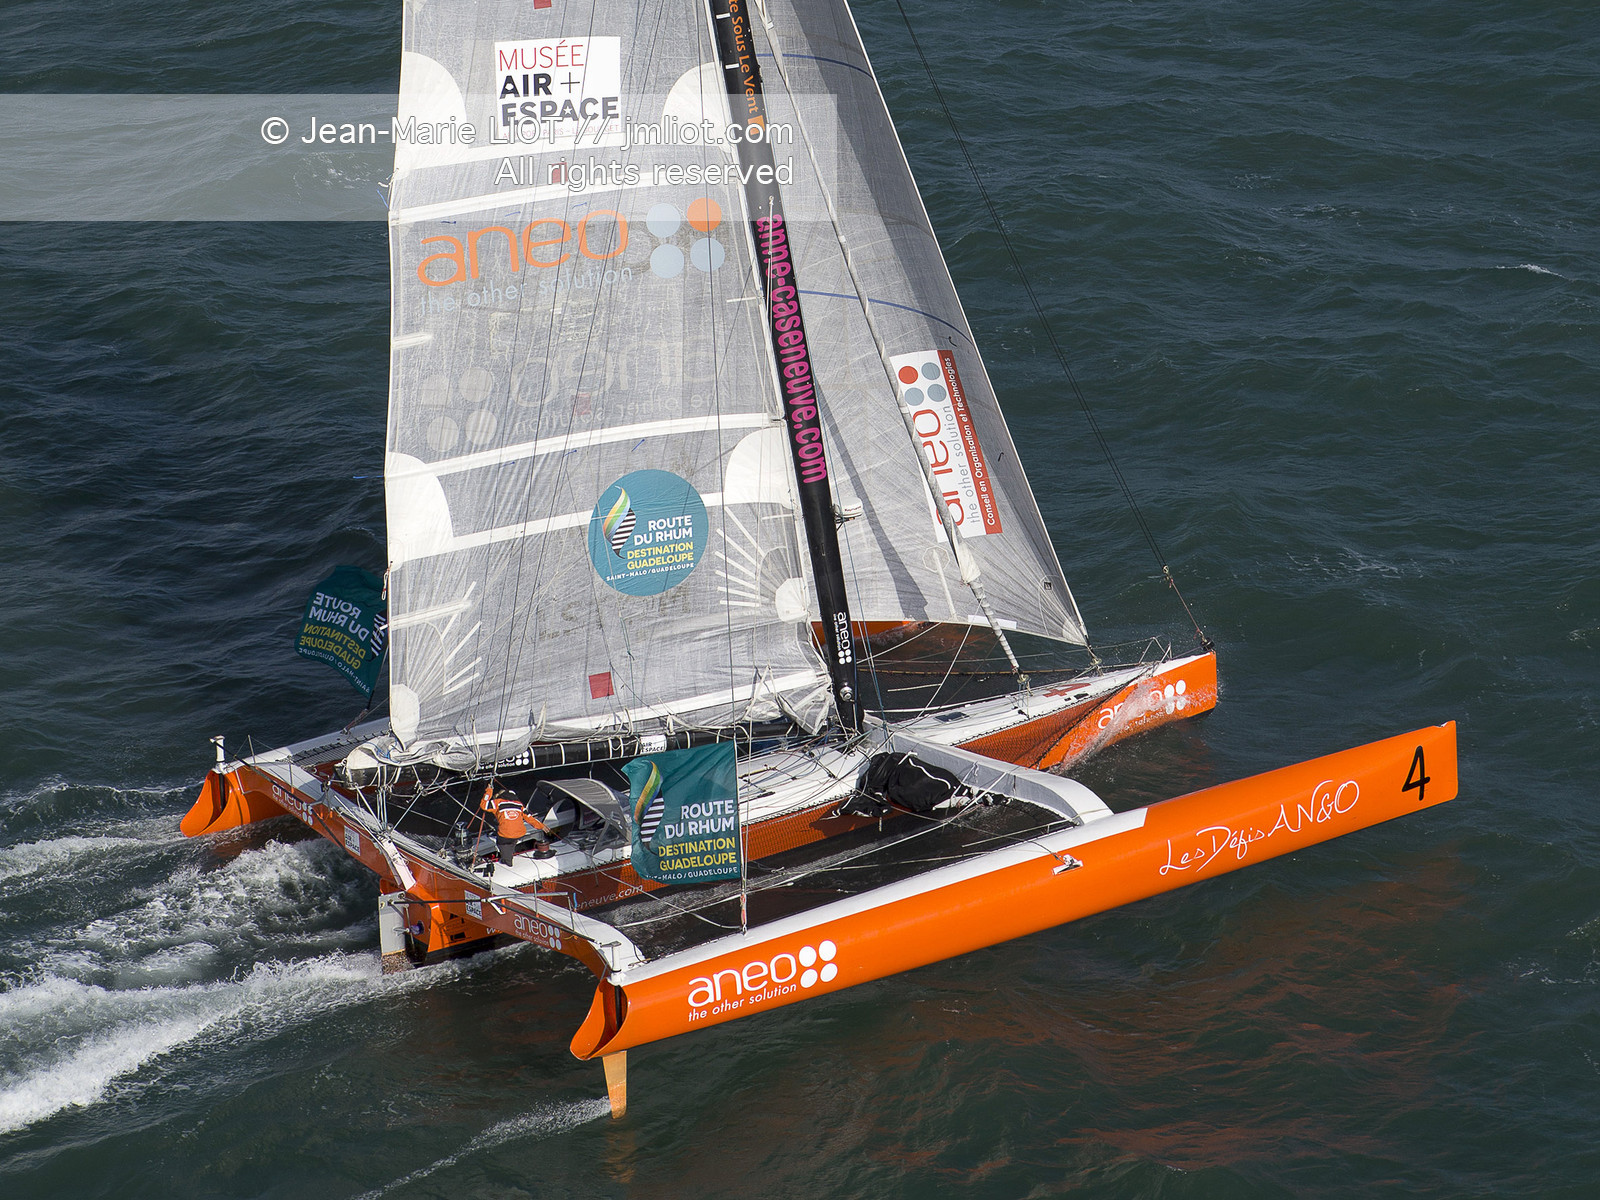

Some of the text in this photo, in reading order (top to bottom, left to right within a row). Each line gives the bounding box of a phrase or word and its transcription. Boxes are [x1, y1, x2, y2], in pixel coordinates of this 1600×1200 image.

[732, 16, 746, 52] Sous
[499, 39, 584, 71] MUSÉE
[739, 54, 751, 73] Le
[499, 73, 553, 99] AIR
[743, 75, 759, 113] Vent
[502, 97, 620, 127] ESPACE
[417, 209, 629, 287] aneo
[420, 265, 633, 317] the other solution
[756, 213, 827, 484] anne-caseneuve.com
[944, 357, 995, 526] Conseil en Organisation et Technologies
[942, 405, 980, 524] the other solution
[634, 527, 693, 546] DU RHUM
[648, 515, 693, 532] ROUTE
[627, 541, 694, 560] DESTINATION
[627, 552, 694, 570] GUADELOUPE
[837, 611, 851, 650] aneo
[1402, 746, 1431, 801] 4
[681, 799, 734, 820] ROUTE
[664, 816, 735, 839] DU RHUM
[658, 837, 736, 857] DESTINATION
[660, 852, 737, 871] GUADELOUPE
[1159, 839, 1206, 875] Les
[514, 914, 548, 938] aneo
[687, 953, 797, 1007] aneo
[688, 984, 797, 1022] the other solution
